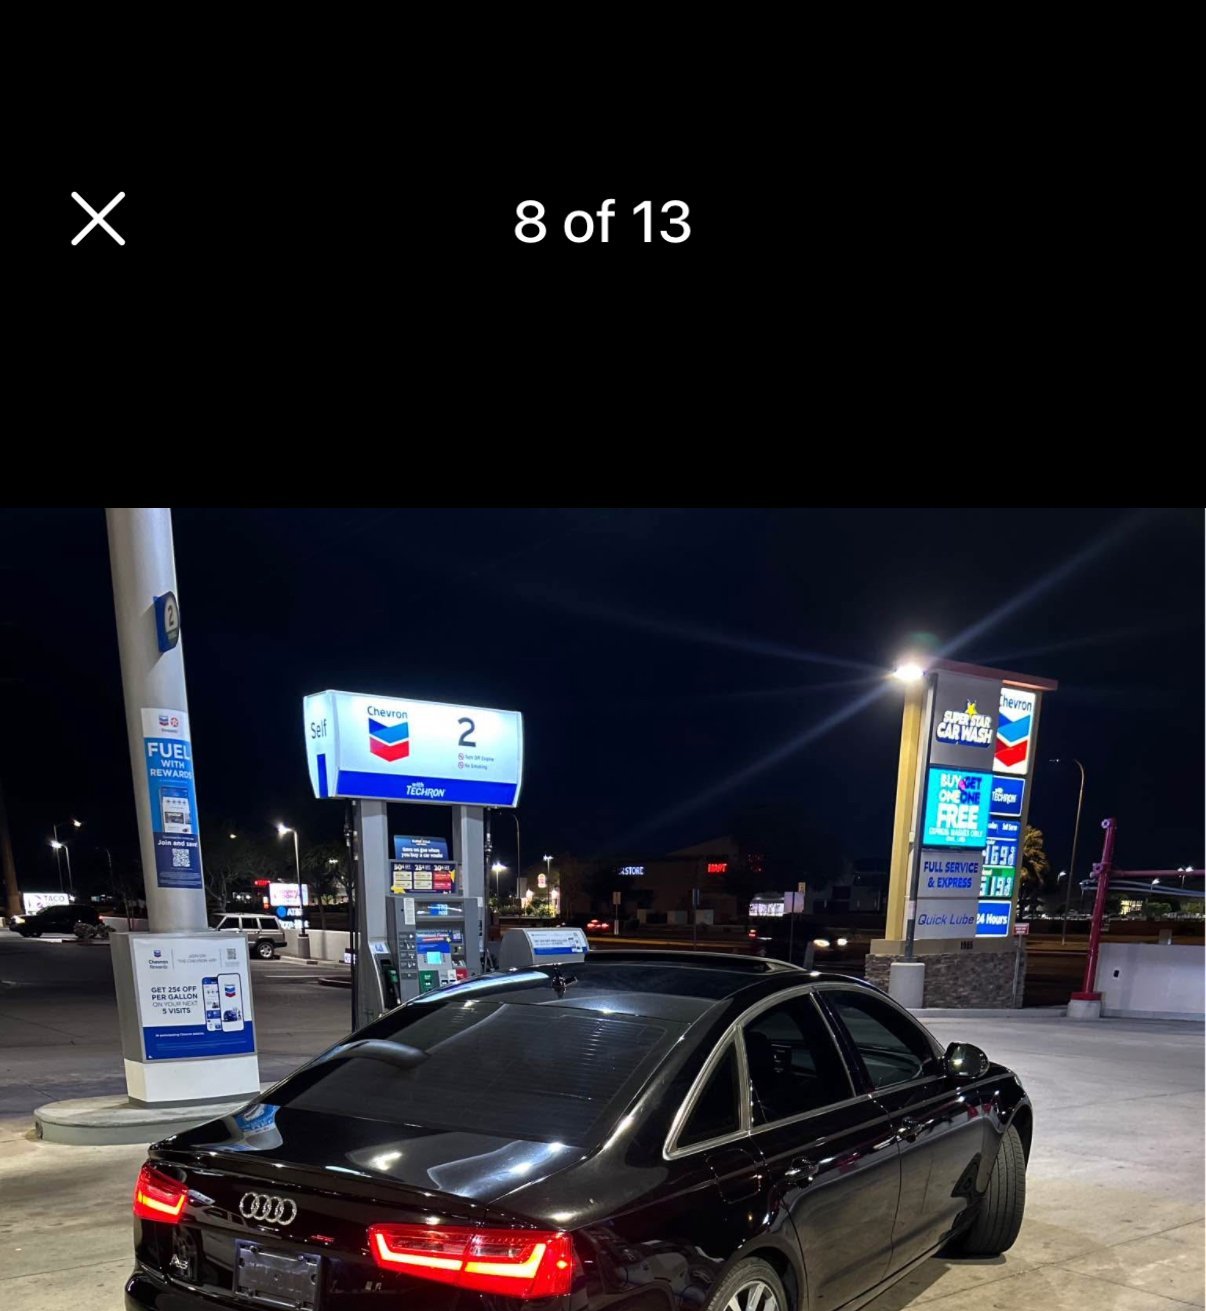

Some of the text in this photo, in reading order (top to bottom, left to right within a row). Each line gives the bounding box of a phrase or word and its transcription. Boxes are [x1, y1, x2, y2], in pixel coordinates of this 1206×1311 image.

[168, 605, 174, 627] 2
[1001, 695, 1032, 711] hevron
[367, 706, 408, 719] Chevron
[944, 710, 991, 728] SUPER STAR
[311, 719, 327, 739] Self
[458, 717, 476, 747] 2
[937, 722, 993, 743] CAR WASH
[147, 742, 191, 760] FUEL
[161, 760, 185, 769] WITH
[150, 769, 192, 779] REWARDS
[940, 773, 982, 790] BUY GET
[406, 785, 445, 798] TECHRON
[939, 789, 980, 805] ONE ONE
[937, 803, 979, 830] FREE
[924, 861, 978, 873] FULL SERVICE
[928, 877, 972, 888] & EXPRESS
[918, 914, 974, 925] Quick Lube
[986, 914, 1007, 925] Hours
